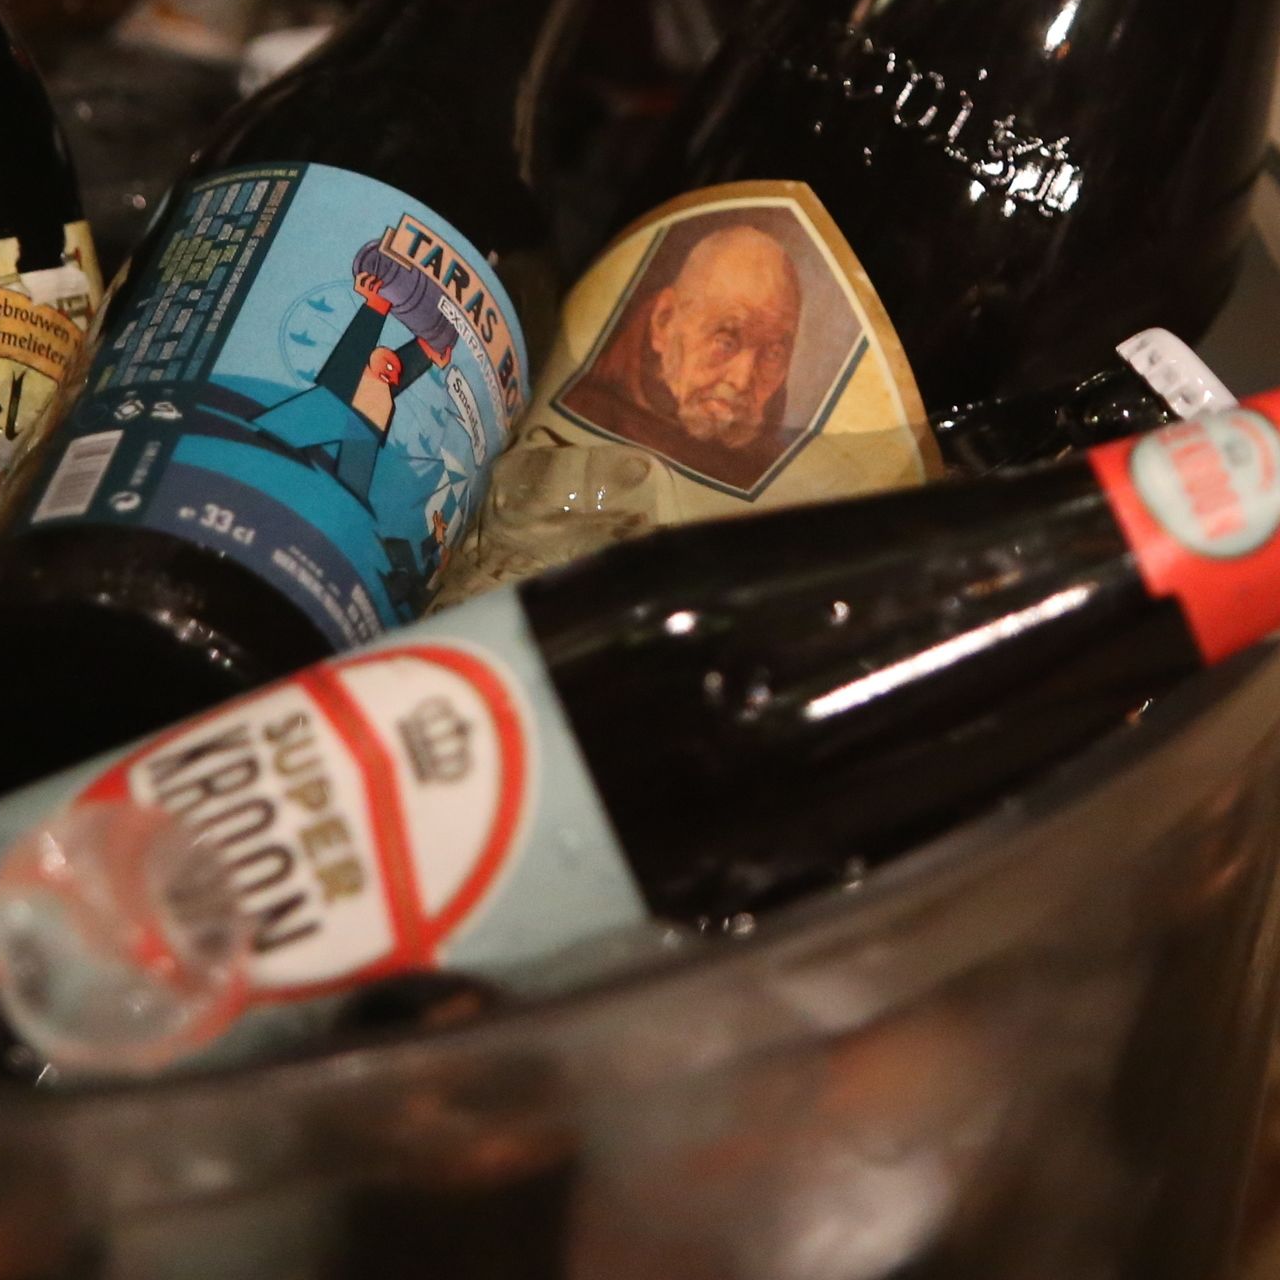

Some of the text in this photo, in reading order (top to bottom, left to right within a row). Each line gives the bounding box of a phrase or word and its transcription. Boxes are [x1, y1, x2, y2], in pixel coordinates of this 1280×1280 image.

[405, 222, 500, 345] TARAS
[439, 299, 486, 363] EXTRA
[199, 503, 236, 533] 33
[148, 725, 320, 953] KROON
[263, 711, 365, 904] SUPER
